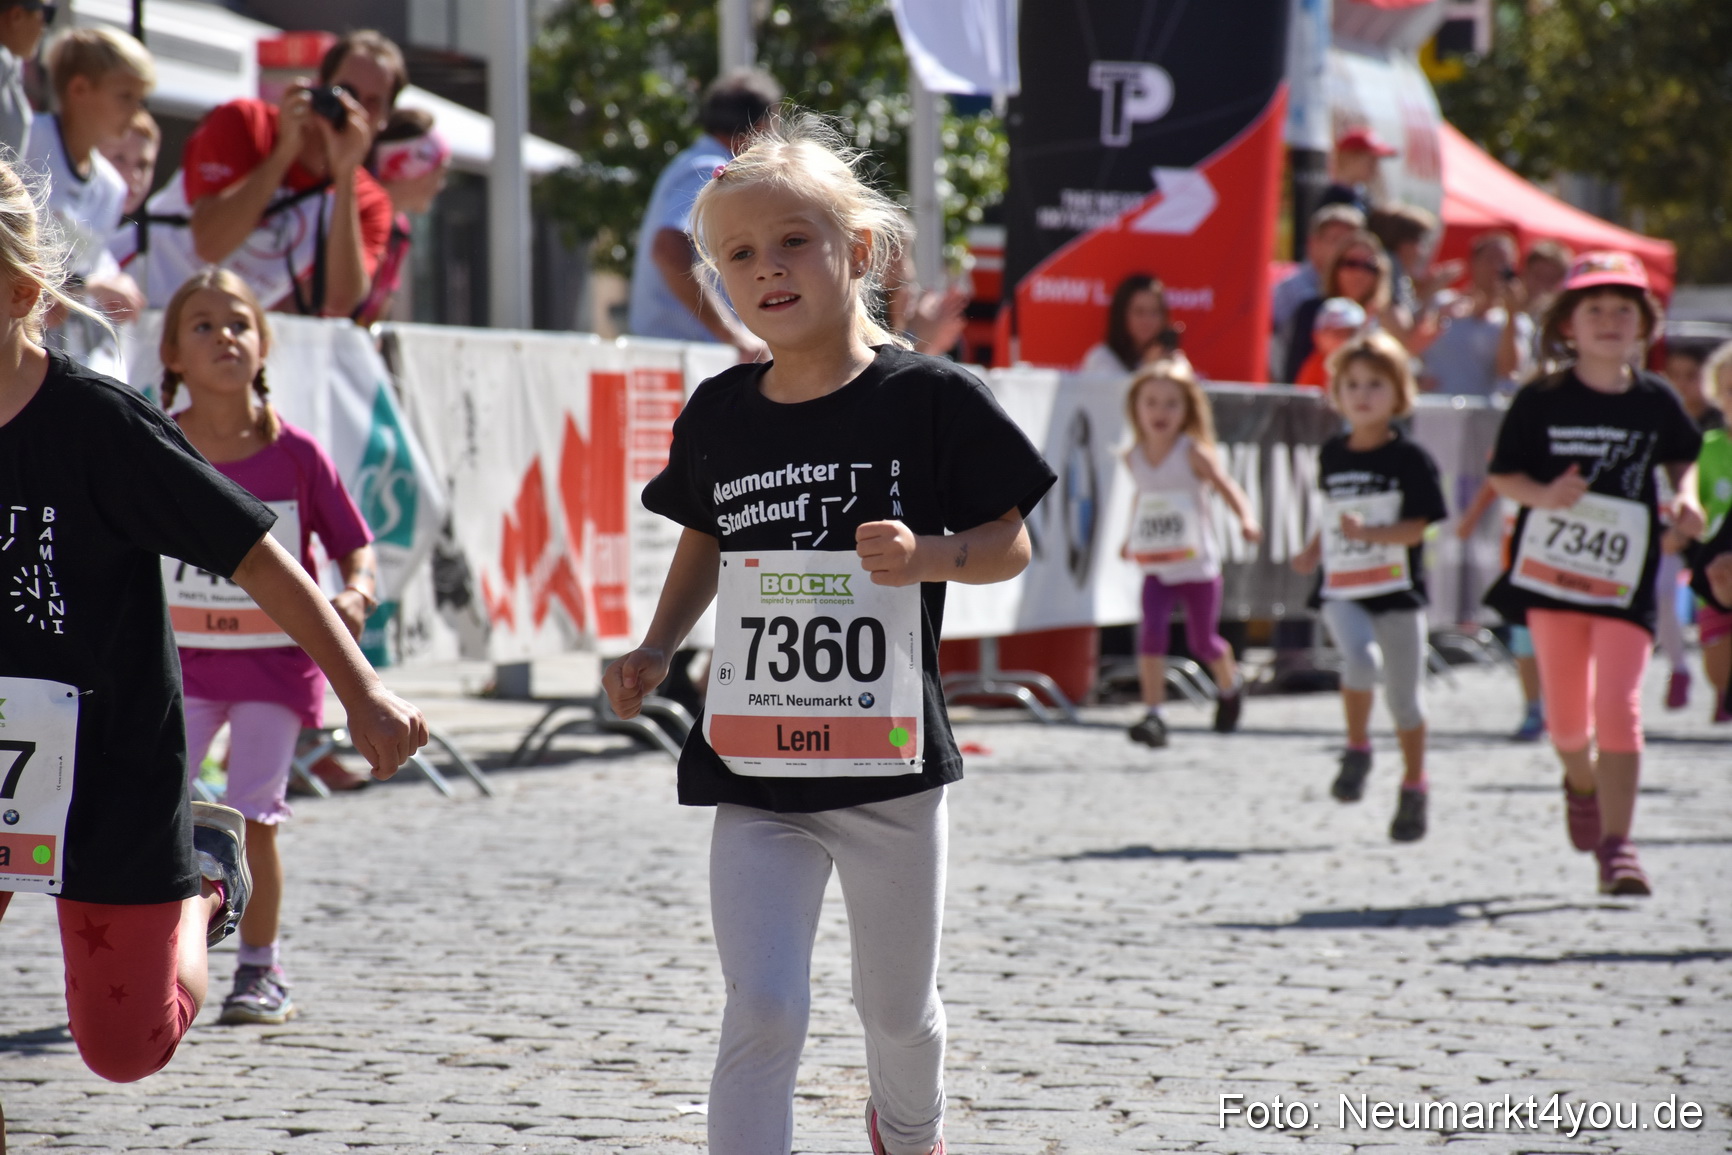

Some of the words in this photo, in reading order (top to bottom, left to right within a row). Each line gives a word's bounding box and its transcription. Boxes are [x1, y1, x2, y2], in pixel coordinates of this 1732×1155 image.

[713, 463, 839, 505] Neumarkter
[717, 493, 811, 536] Stadtlauf
[1546, 516, 1629, 566] 7349
[761, 573, 853, 596] BOCK
[761, 597, 784, 605] inspired
[785, 597, 794, 605] by
[207, 613, 239, 631] Lea
[741, 616, 886, 682] 7360
[719, 668, 732, 680] B1
[749, 694, 783, 706] PARTL
[786, 694, 852, 706] Neumarkt
[777, 724, 830, 752] Leni
